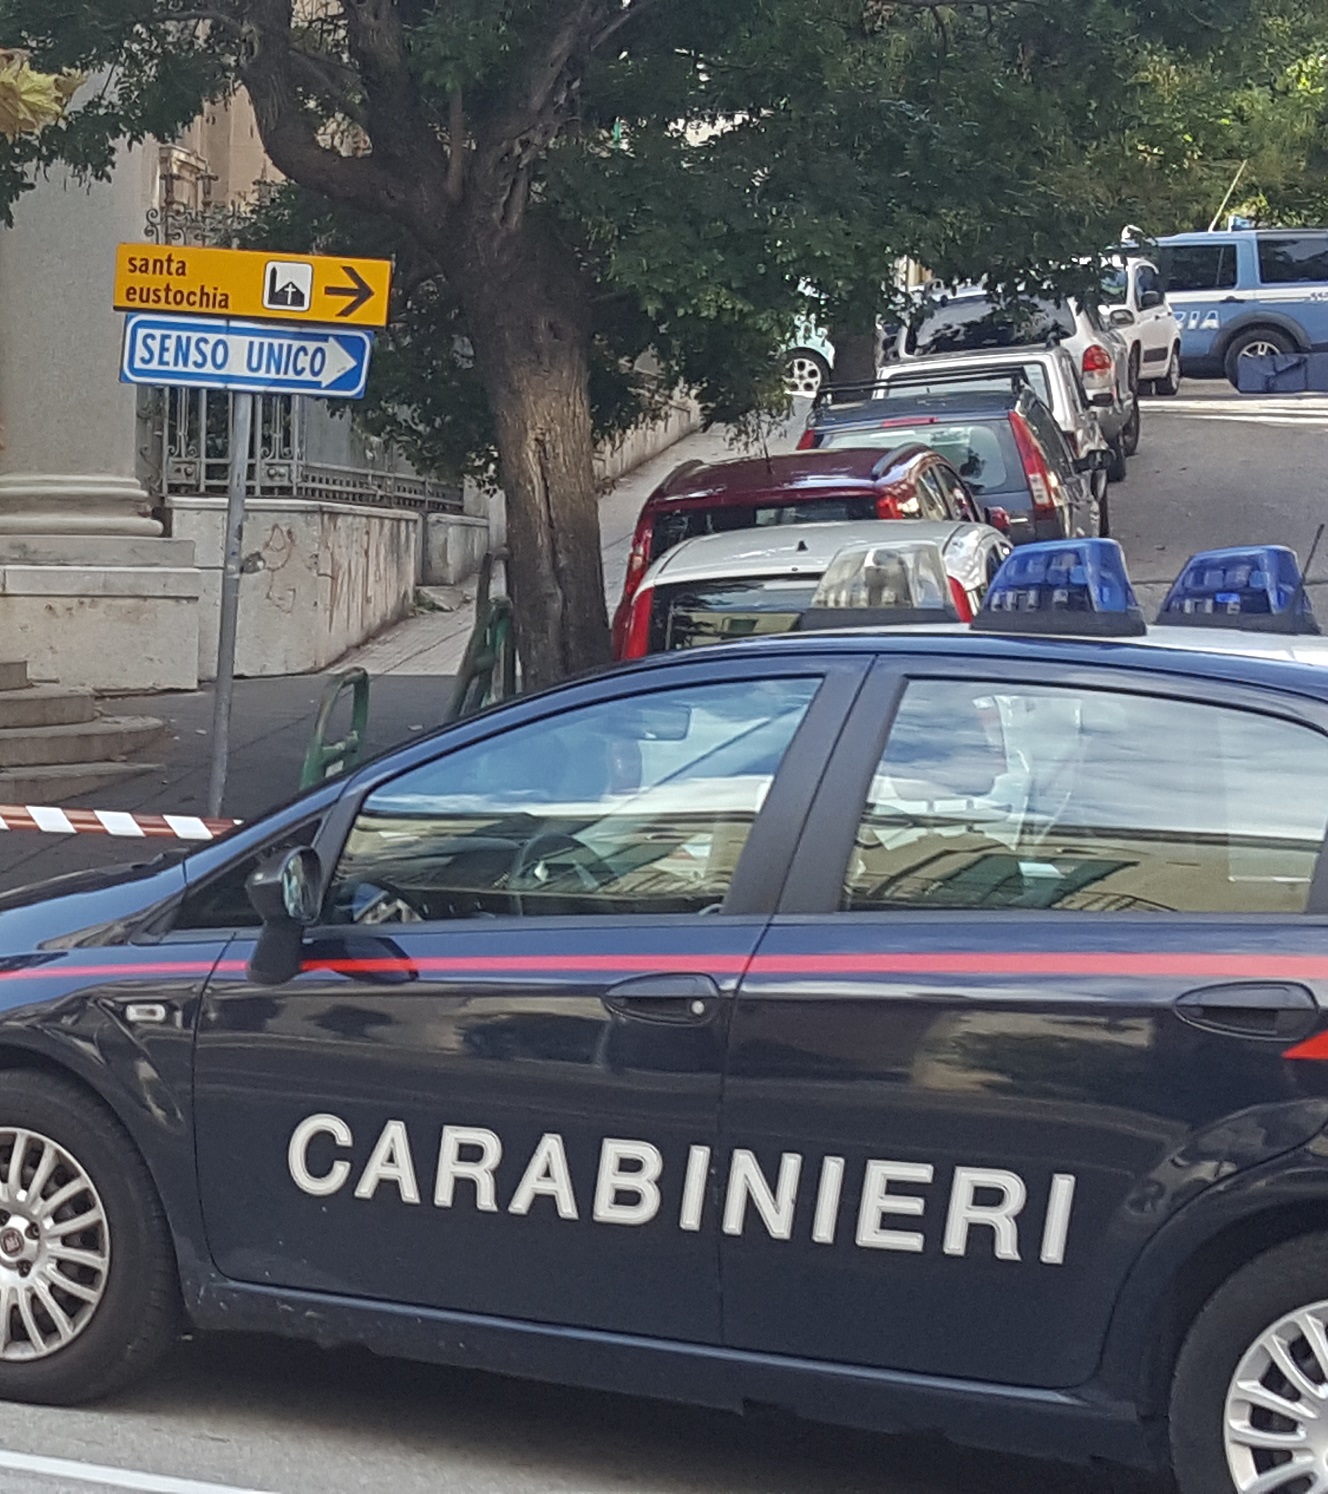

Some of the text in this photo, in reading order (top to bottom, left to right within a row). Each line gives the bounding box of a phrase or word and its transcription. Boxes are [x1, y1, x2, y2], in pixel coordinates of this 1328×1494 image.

[128, 253, 187, 276] santa
[125, 284, 230, 309] eustochia
[140, 333, 327, 377] SENSO UNICO
[287, 1112, 1076, 1265] CARABINIERI
